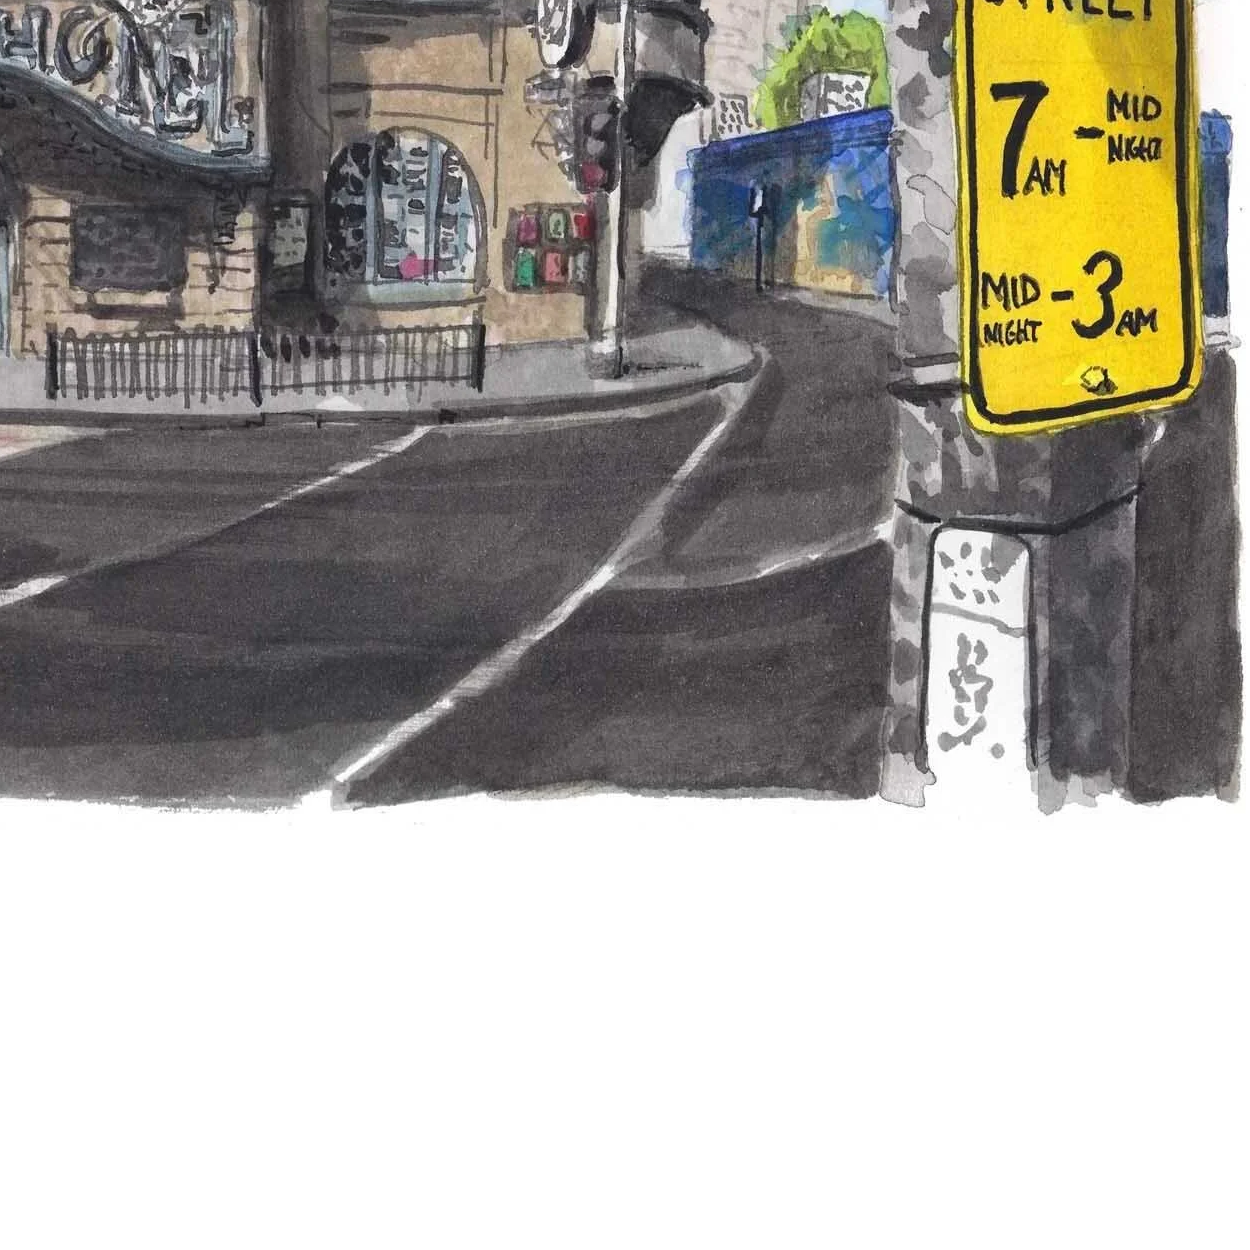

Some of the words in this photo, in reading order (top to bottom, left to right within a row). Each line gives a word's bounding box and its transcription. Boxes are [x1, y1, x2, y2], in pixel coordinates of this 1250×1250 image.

[1106, 87, 1162, 122] MID
[981, 271, 1041, 312] MID
[982, 318, 1042, 347] NIGHT
